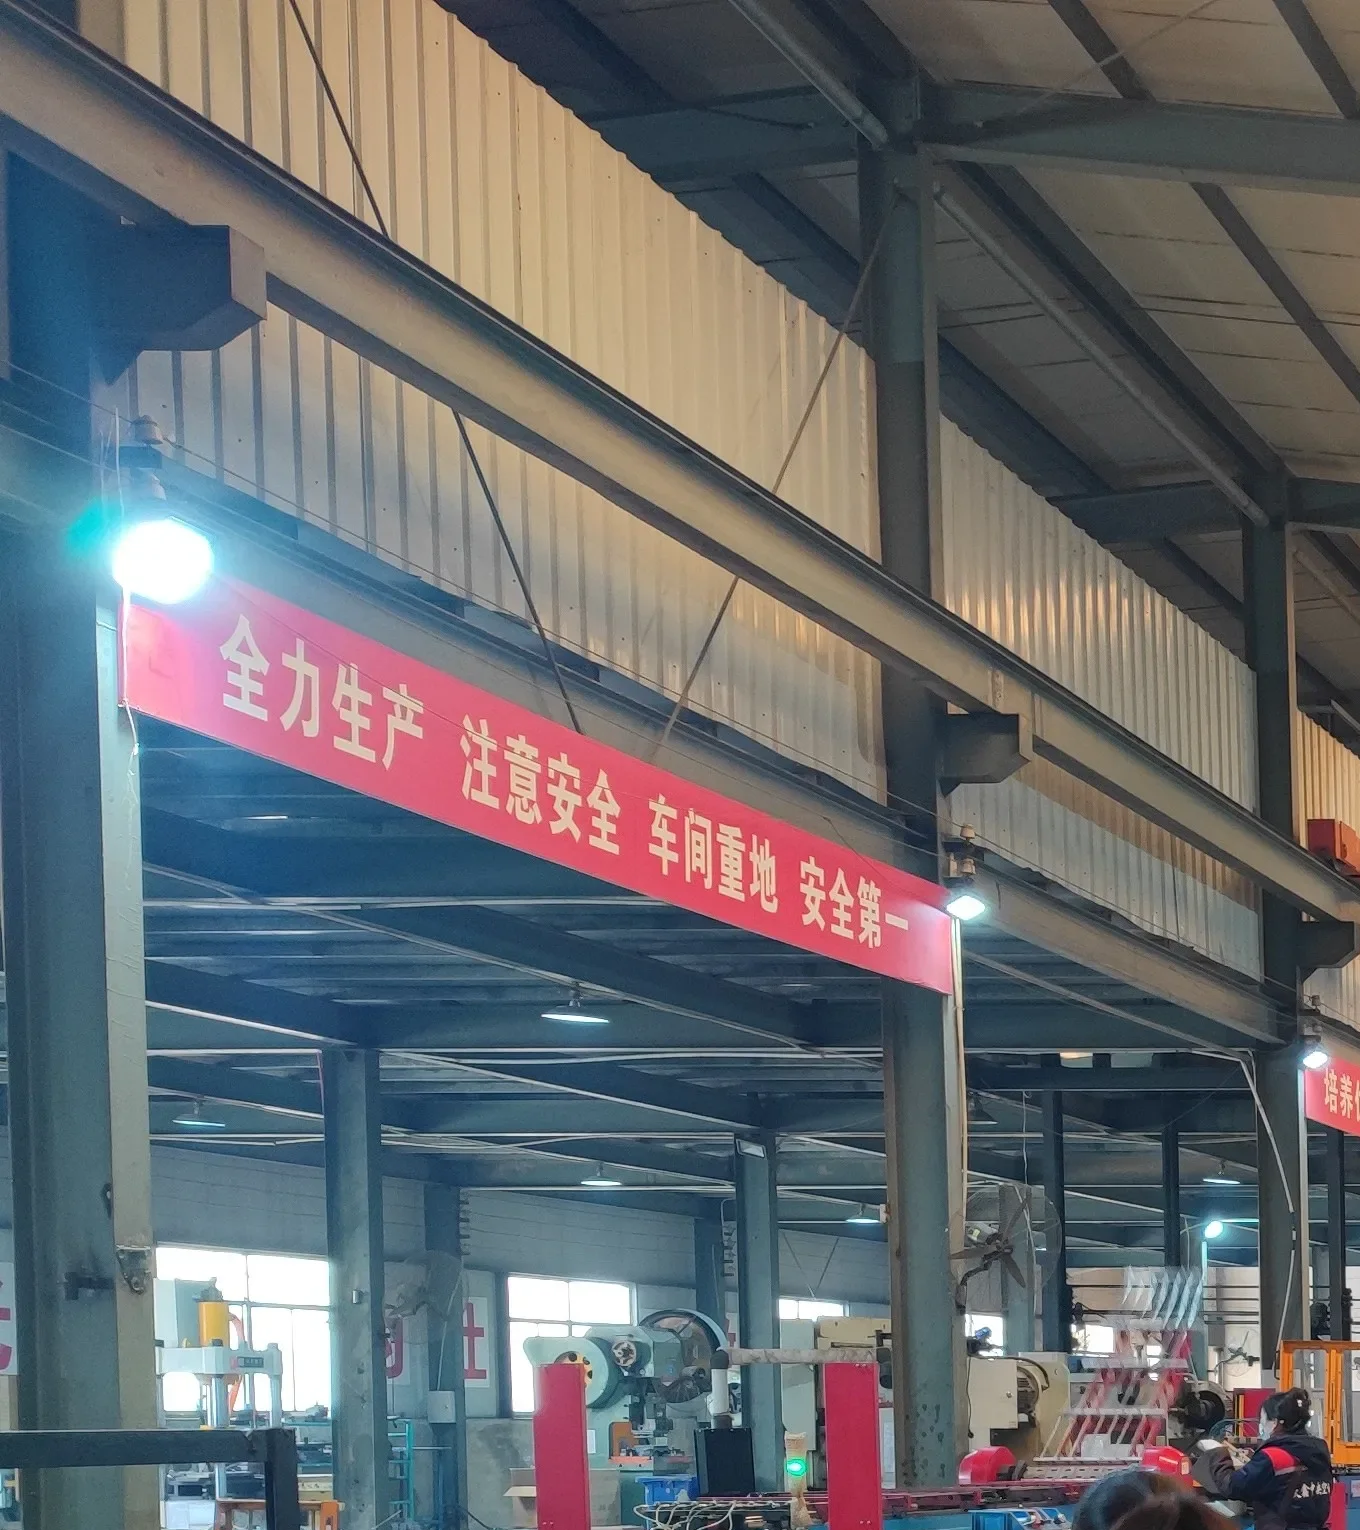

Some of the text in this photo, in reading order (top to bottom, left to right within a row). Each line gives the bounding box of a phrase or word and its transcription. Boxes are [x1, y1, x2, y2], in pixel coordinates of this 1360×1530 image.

[219, 615, 910, 949] 全力生产 注意安全 车间重地 安全第一
